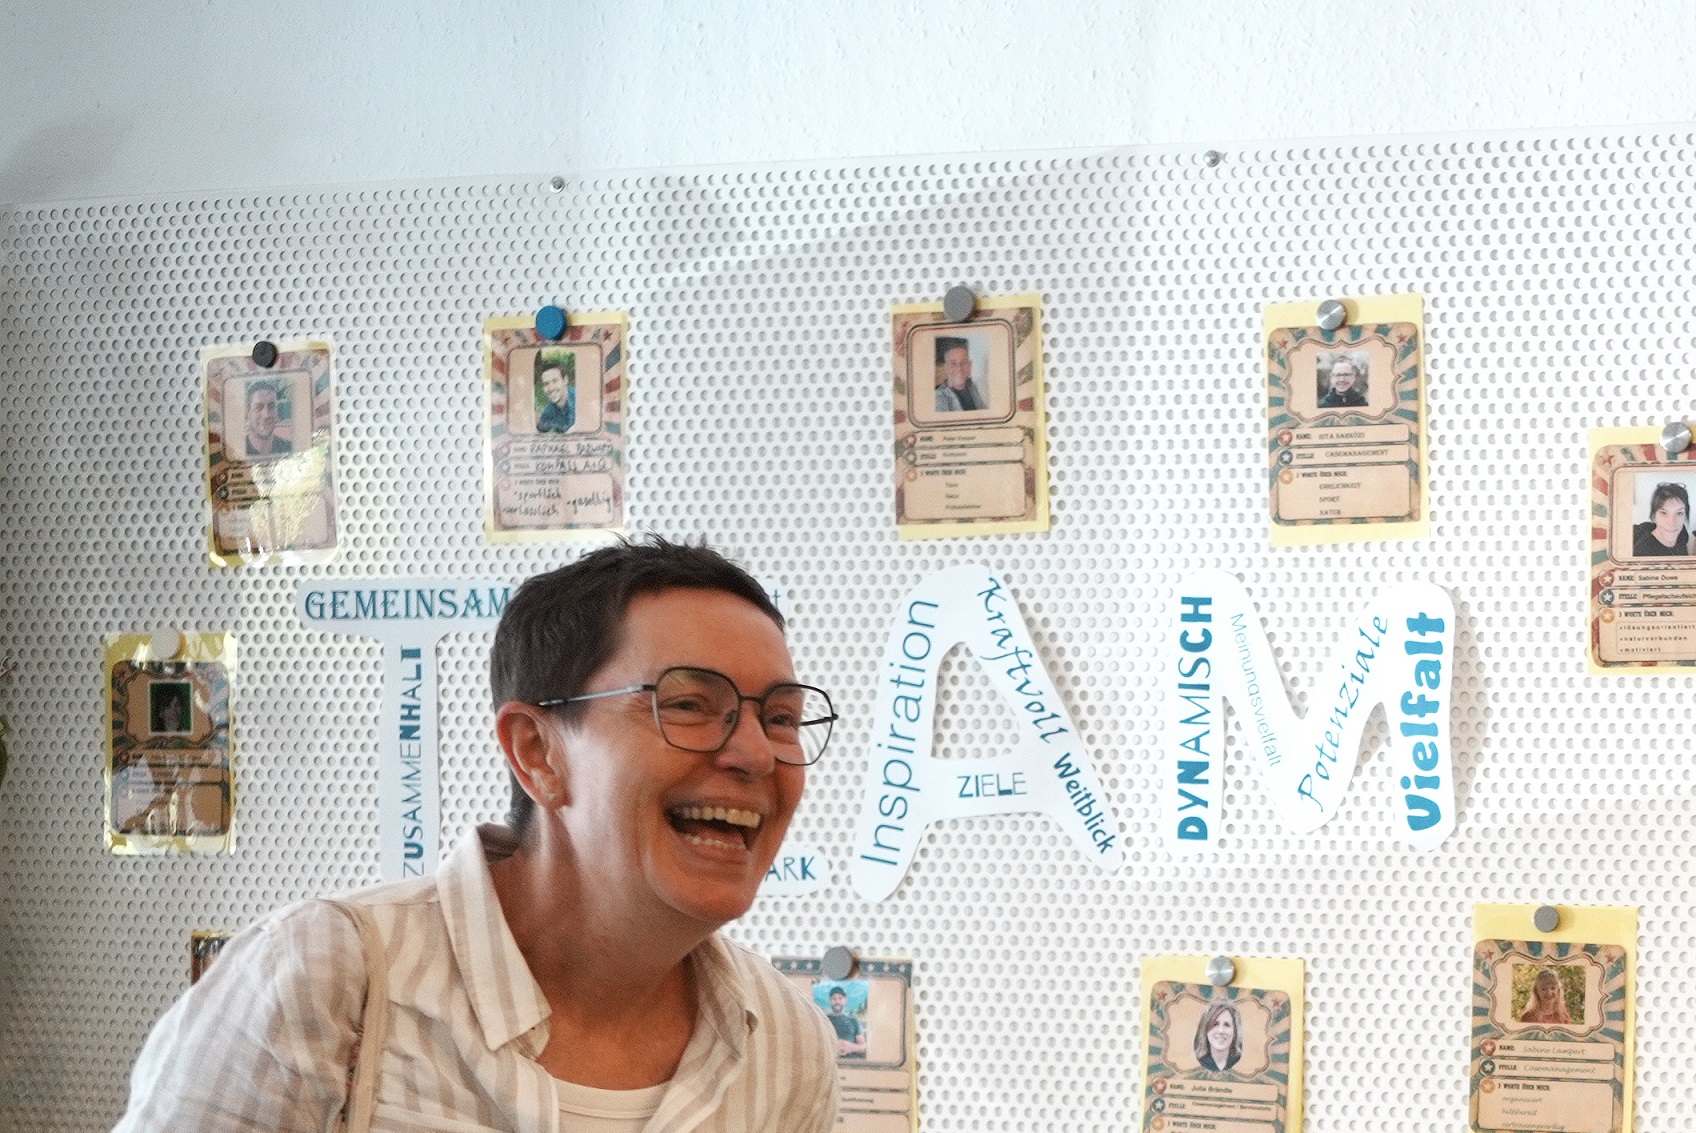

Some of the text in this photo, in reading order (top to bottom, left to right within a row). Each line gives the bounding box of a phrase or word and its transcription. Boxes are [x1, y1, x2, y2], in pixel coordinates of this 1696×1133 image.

[860, 600, 939, 866] Inspiration
[977, 577, 1069, 745] Kraftvoll
[1176, 596, 1213, 841] DYNAMISCH
[1230, 613, 1281, 768] Meinungsvielfalt
[1297, 616, 1388, 813] Potenziale
[1400, 611, 1446, 832] Vielfalt
[399, 643, 425, 879] ZUSAMMENHALT
[956, 772, 1028, 799] ZIELE
[1053, 752, 1117, 855] Weitblick
[764, 855, 817, 882] ARK
